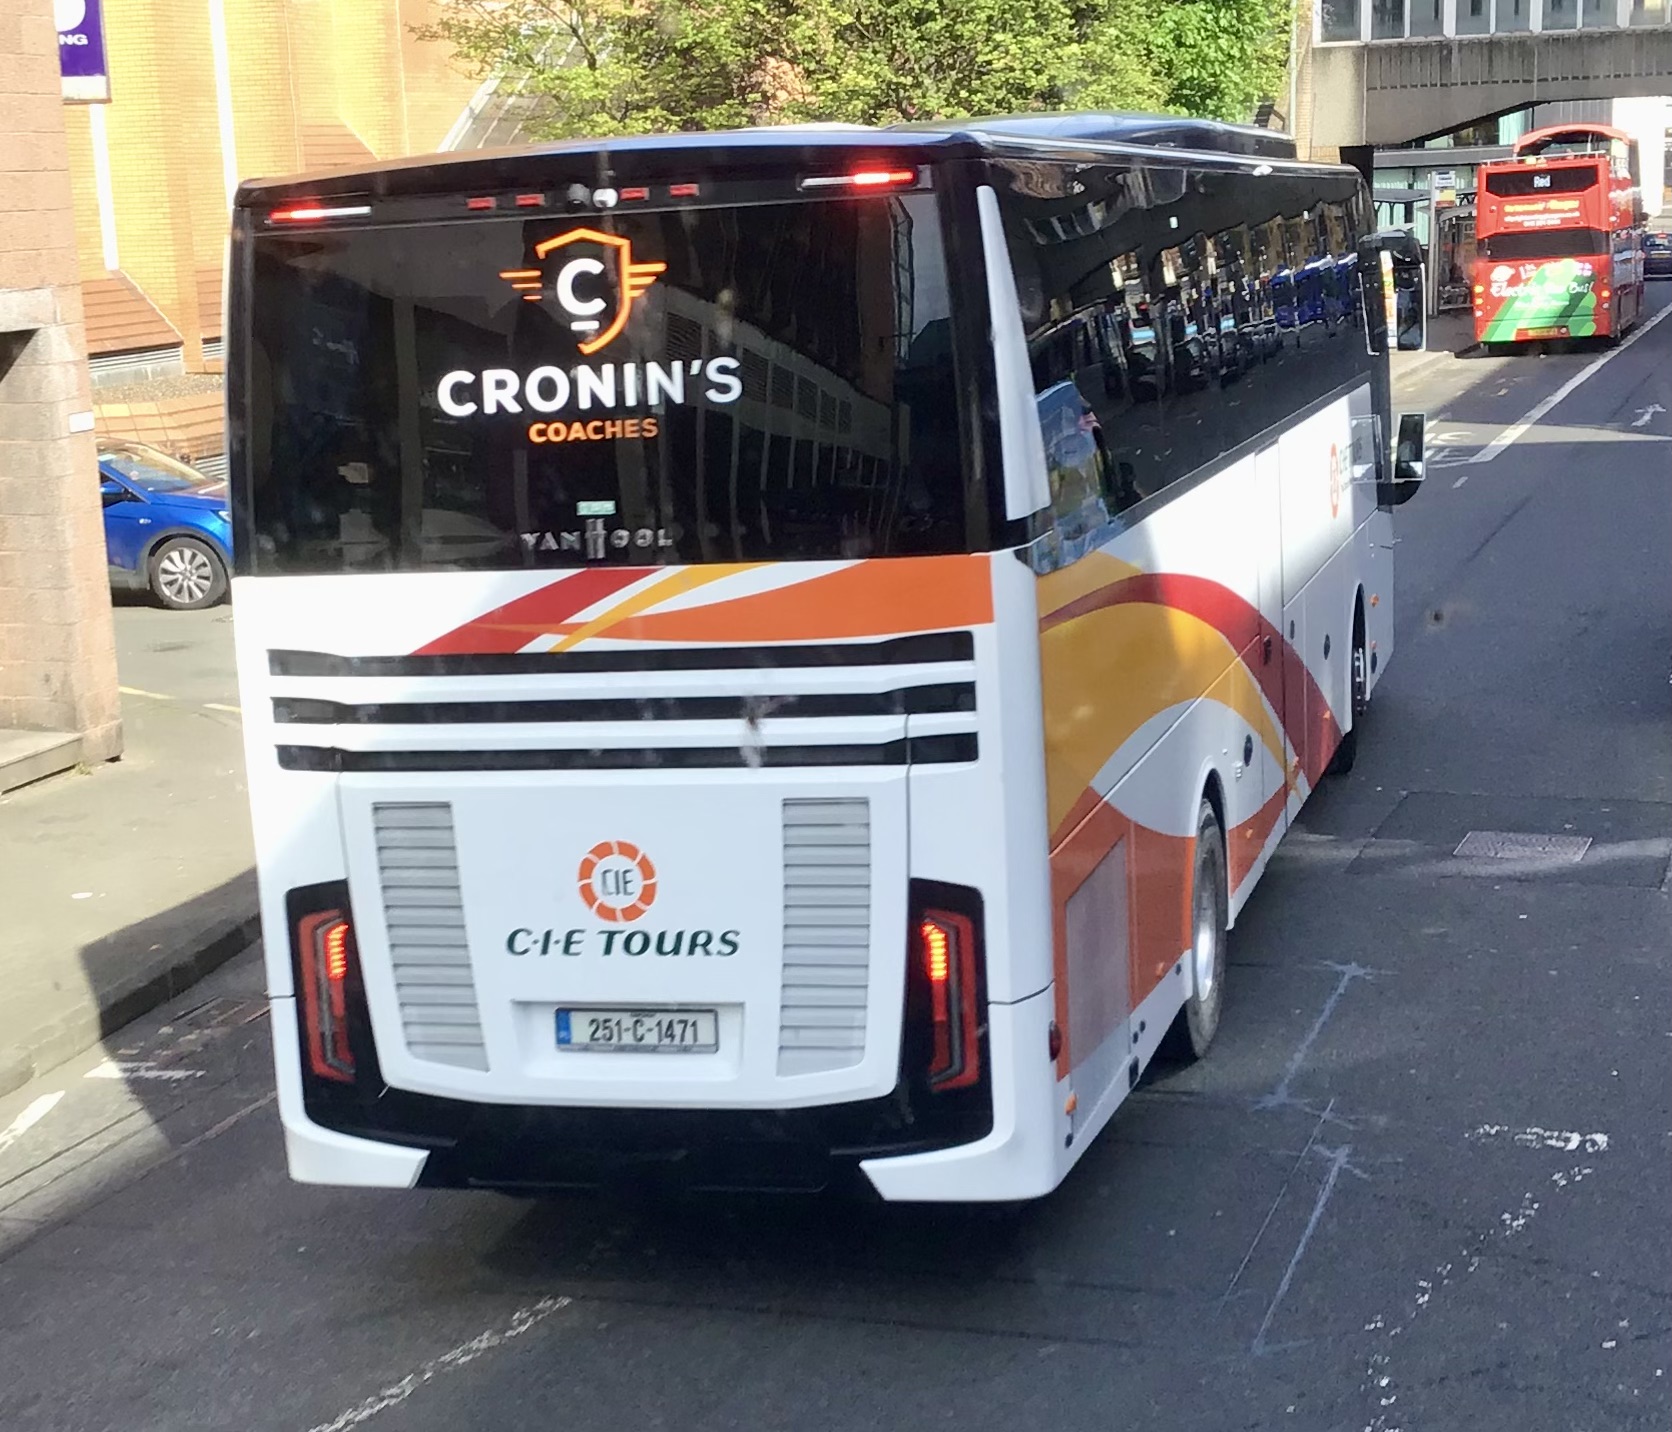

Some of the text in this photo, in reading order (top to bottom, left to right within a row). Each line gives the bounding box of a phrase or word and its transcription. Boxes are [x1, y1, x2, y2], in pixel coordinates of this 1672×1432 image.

[1533, 174, 1551, 188] Red
[557, 257, 607, 316] C
[437, 357, 743, 417] CRONIN'S
[529, 418, 658, 443] COACHES
[601, 868, 635, 896] CIE
[596, 930, 740, 956] TOURS
[588, 1018, 698, 1043] 251-C-1471
